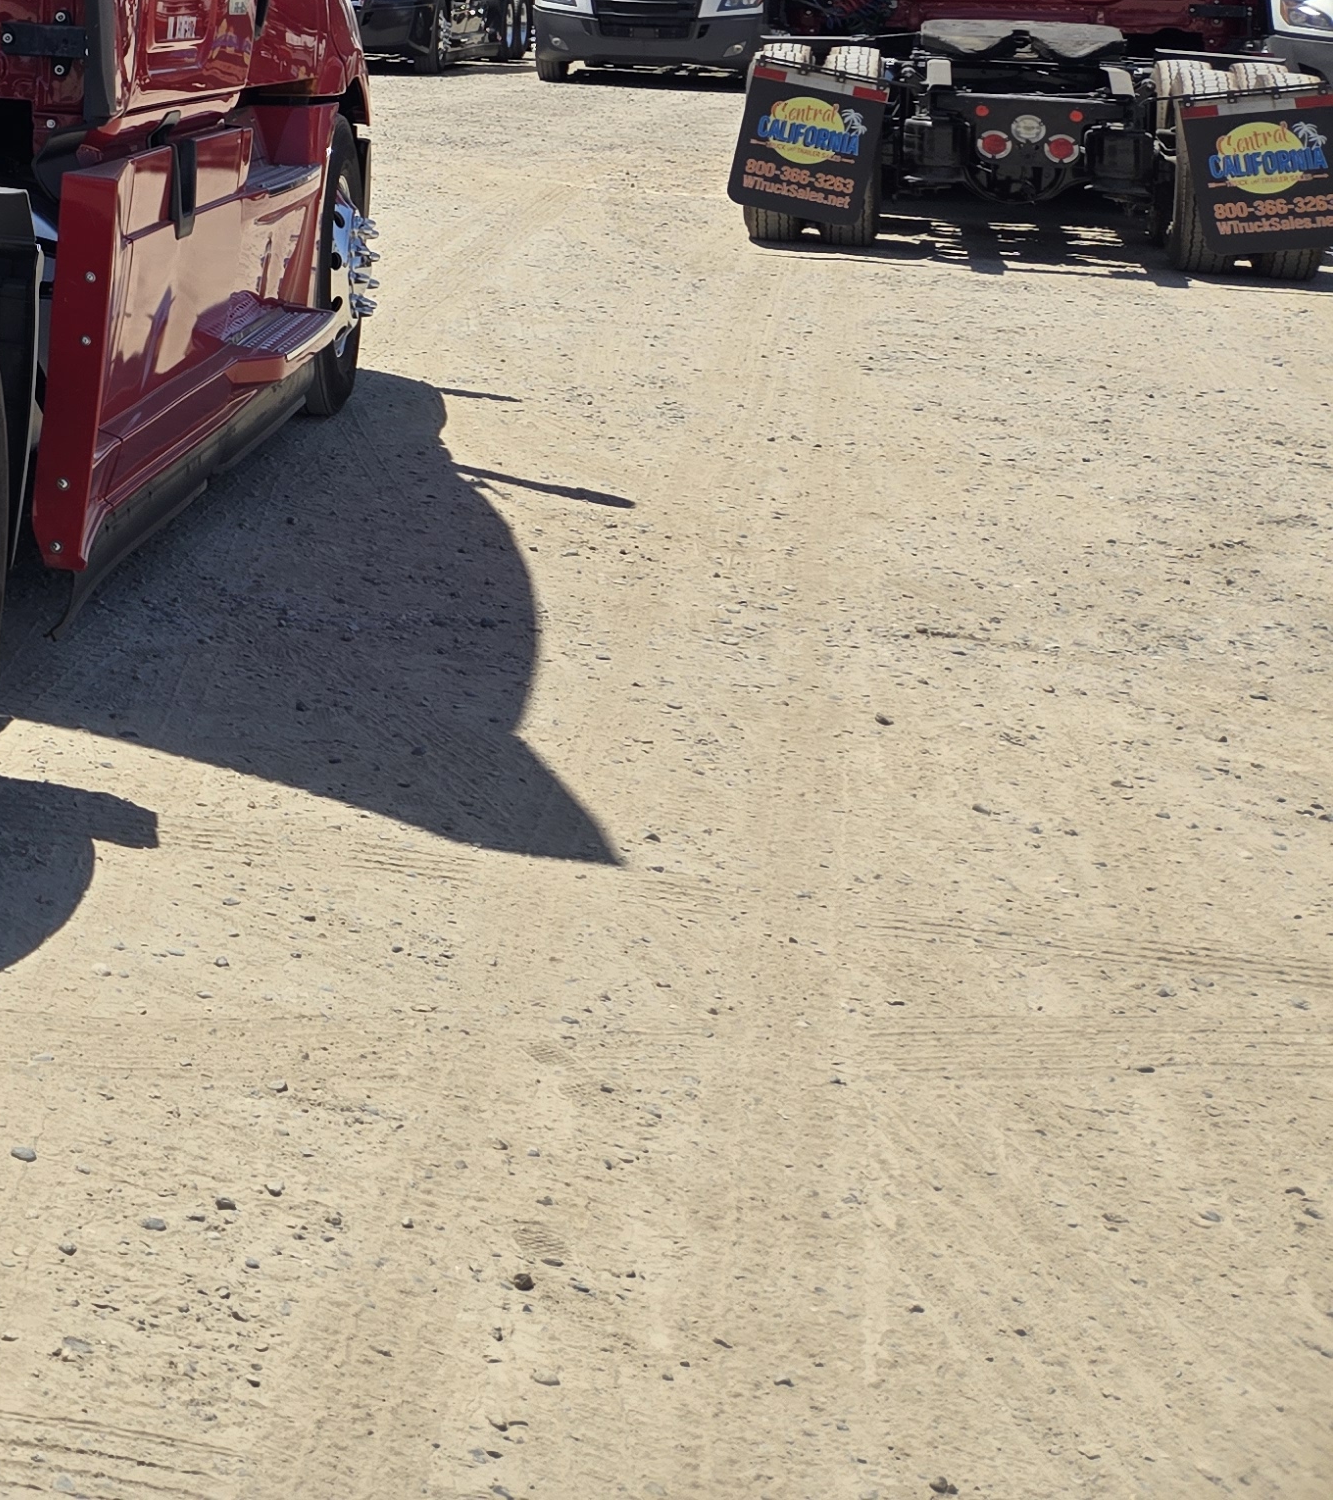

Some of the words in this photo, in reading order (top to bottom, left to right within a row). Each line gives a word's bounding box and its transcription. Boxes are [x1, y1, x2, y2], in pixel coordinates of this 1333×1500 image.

[770, 101, 840, 125] Central
[757, 115, 859, 156] CALIFORNIA
[1216, 121, 1290, 156] Central
[744, 158, 855, 194] 800-366-3263
[1208, 146, 1329, 178] CALIFORNIA
[742, 174, 851, 209] WTruckSales.net
[1216, 215, 1333, 235] WTruckSales.ne
